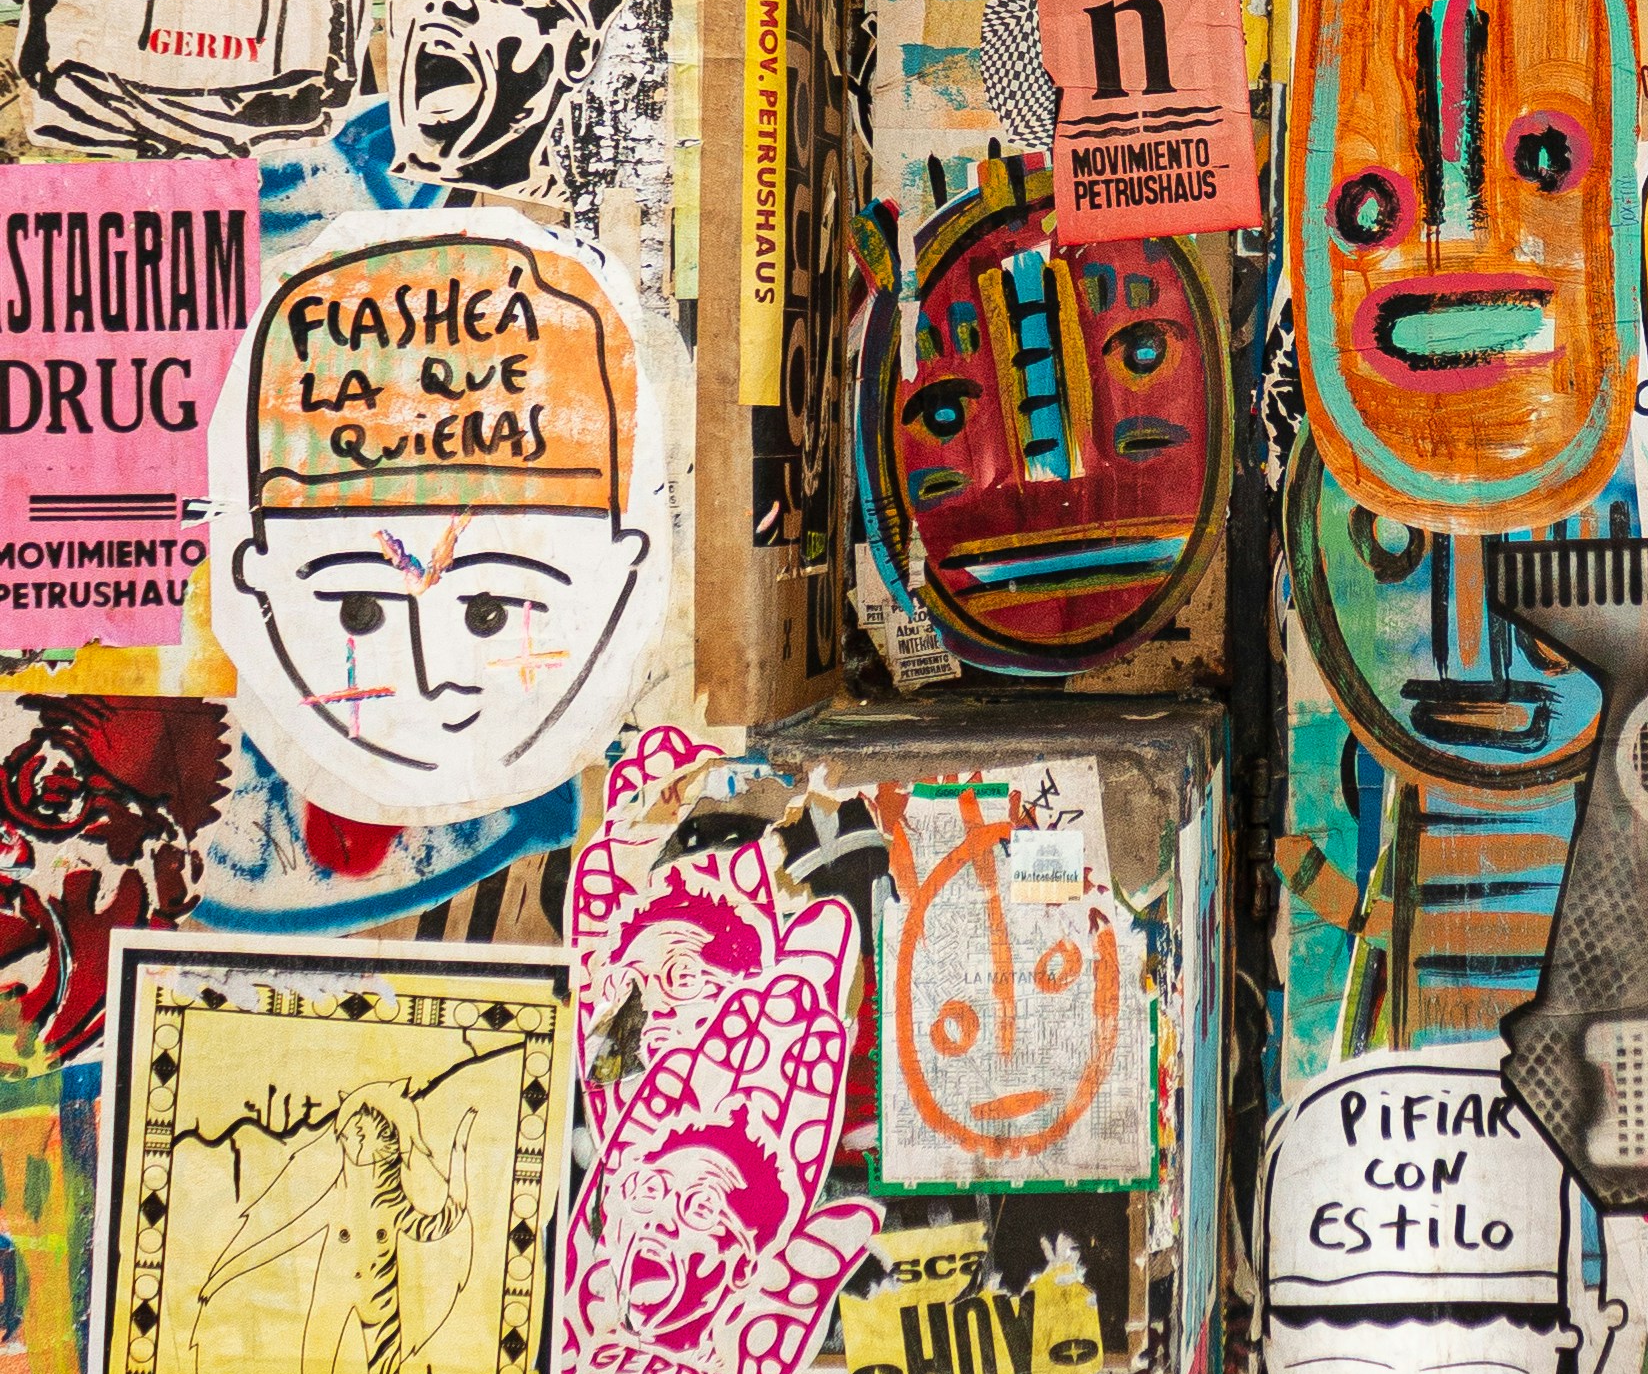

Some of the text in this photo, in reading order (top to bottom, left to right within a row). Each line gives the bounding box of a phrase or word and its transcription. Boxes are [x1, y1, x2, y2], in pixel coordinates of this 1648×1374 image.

[149, 28, 266, 62] GERDY
[1071, 139, 1211, 177] MOVIMIENTO
[754, 91, 778, 304] PETRUSHAUS
[1073, 171, 1217, 210] PETRUSHAUS
[300, 370, 384, 414] LA
[0, 539, 207, 569] MOVIMIENTO
[0, 580, 187, 609] PETRUSHAU
[900, 663, 953, 679] PETRUSHAUS
[964, 972, 982, 984] LA
[1364, 1151, 1468, 1194] CON
